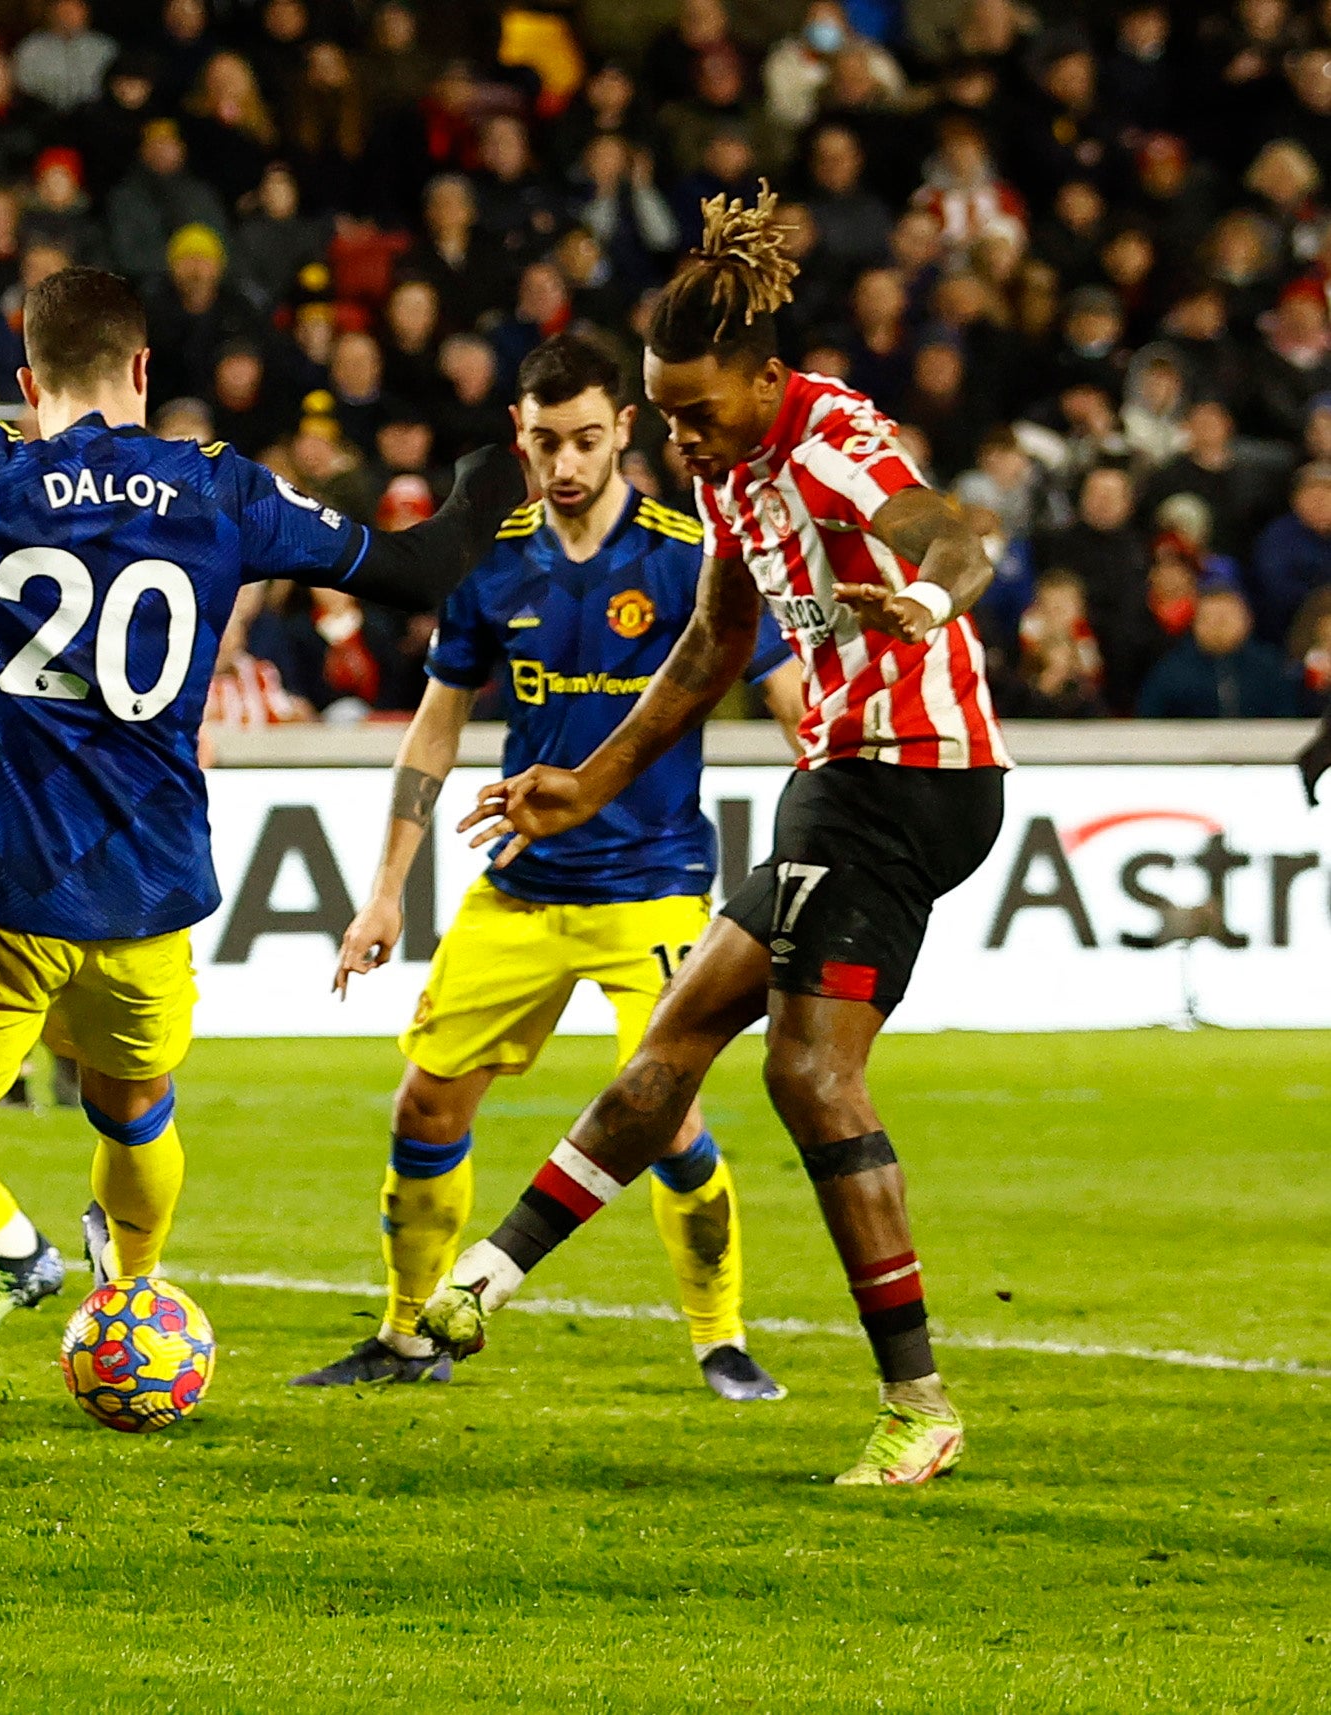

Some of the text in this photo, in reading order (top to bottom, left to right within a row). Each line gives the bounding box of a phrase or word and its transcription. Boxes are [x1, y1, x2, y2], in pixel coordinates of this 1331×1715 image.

[42, 467, 179, 516] DALOT
[543, 671, 653, 696] TeamViewe
[772, 861, 831, 933] 17
[986, 816, 1331, 949] Astr
